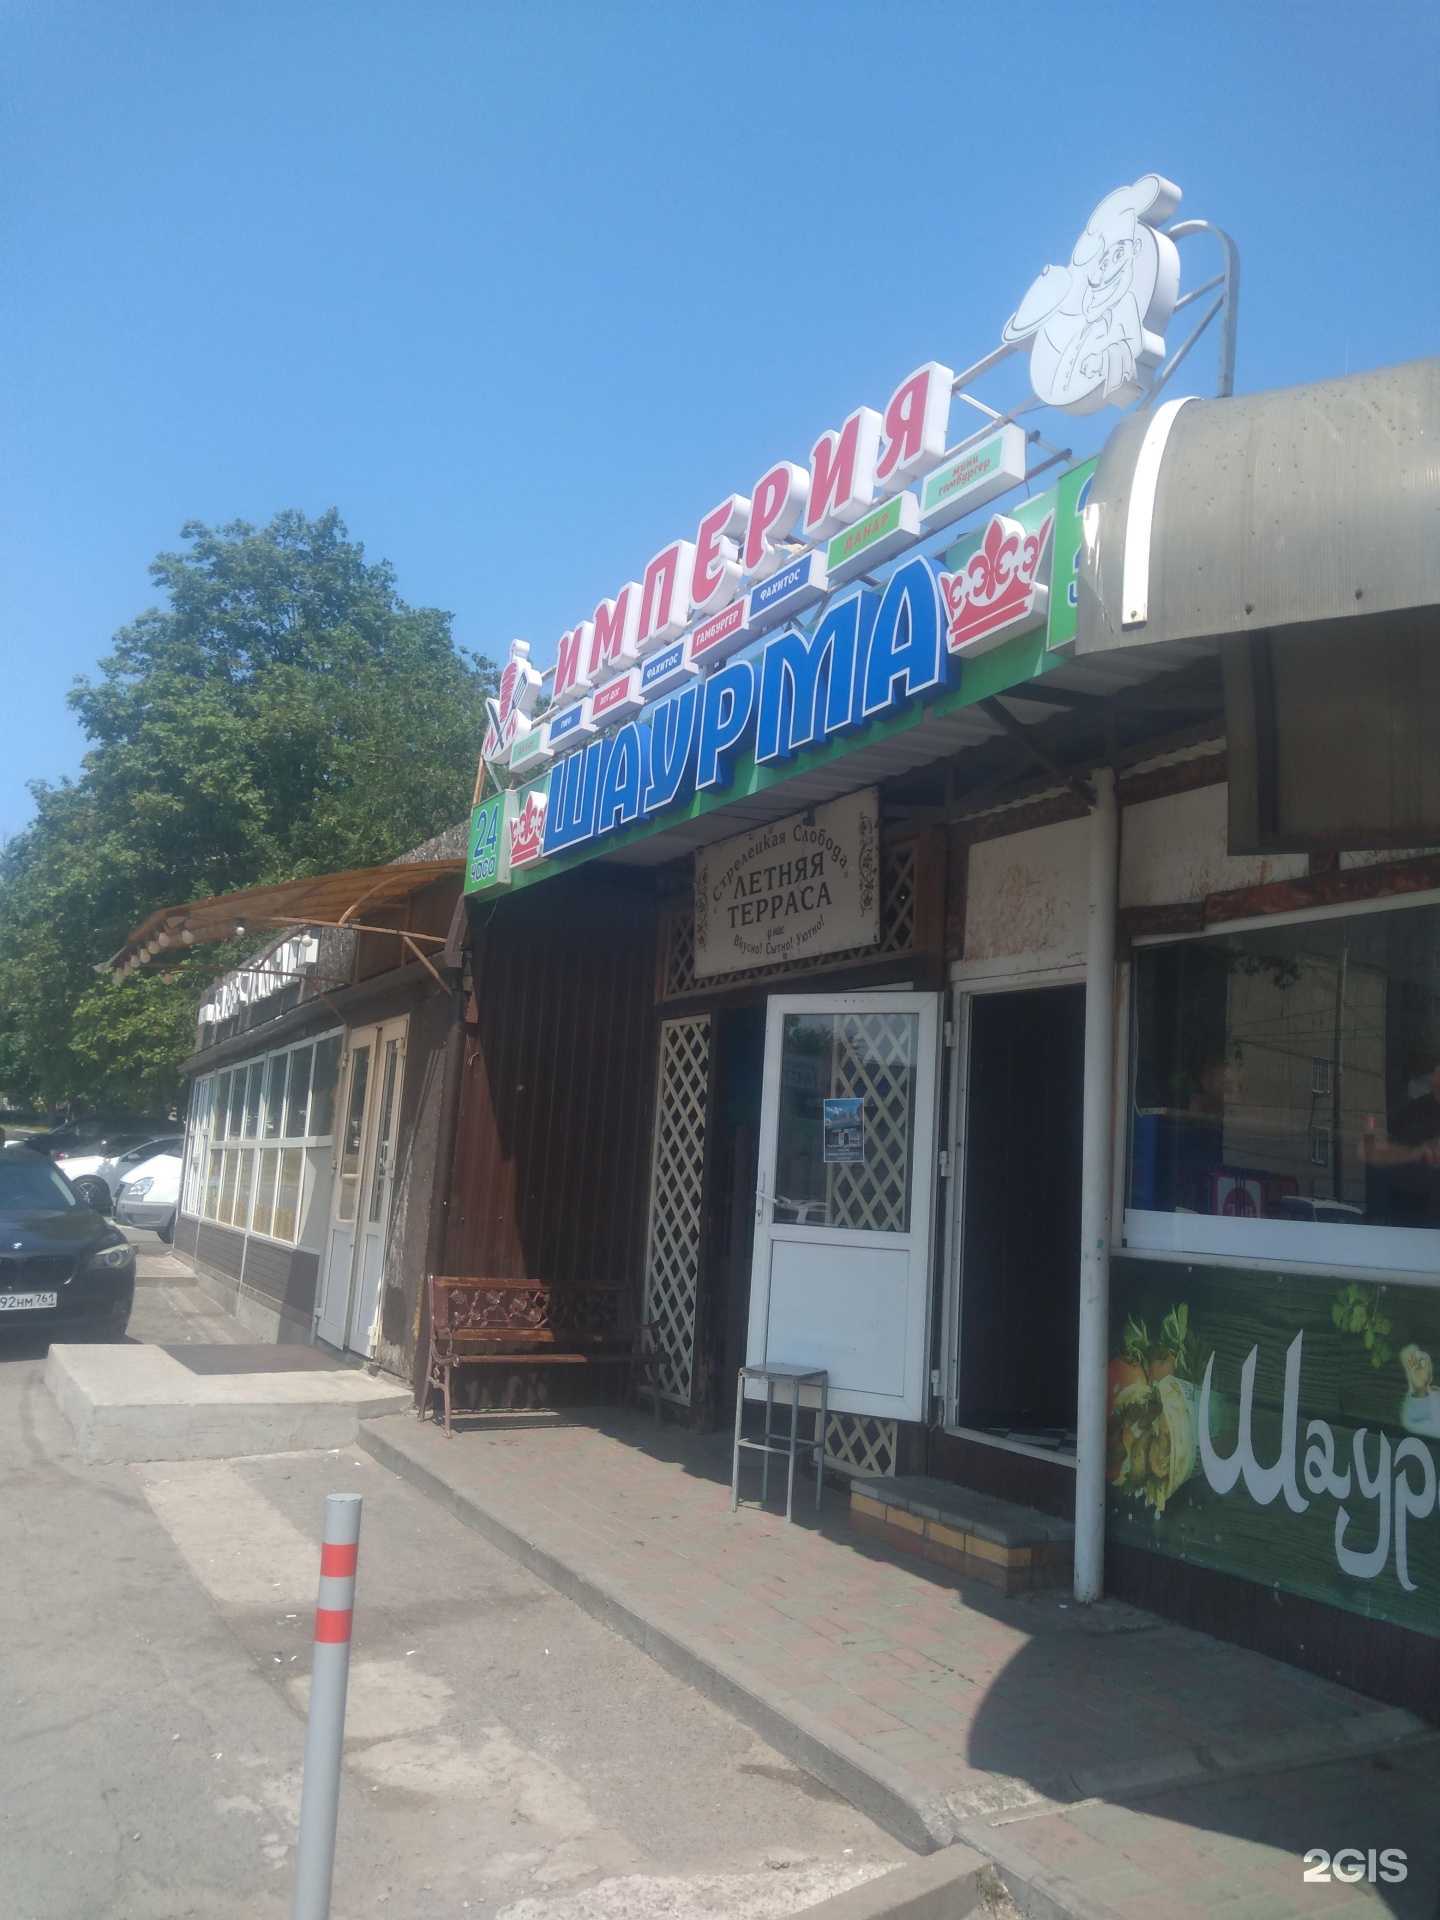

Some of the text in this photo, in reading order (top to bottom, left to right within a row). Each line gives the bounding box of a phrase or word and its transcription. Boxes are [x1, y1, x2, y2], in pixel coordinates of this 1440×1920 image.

[550, 361, 944, 702] ИМПЕРИЯ
[760, 568, 800, 601] ФАХИТОС
[696, 610, 739, 647] ГАМБУРГЕР
[646, 652, 679, 679] ФАХИТОС
[541, 554, 942, 858] ШАУРМА
[473, 803, 500, 859] 24
[712, 824, 848, 902] Стрелецкая Слобода
[733, 851, 825, 900] ЛЕТНЯЯ
[727, 881, 833, 929] ТЕРРАСА
[36, 1294, 54, 1305] 761
[1199, 1329, 1440, 1592] Шаур
